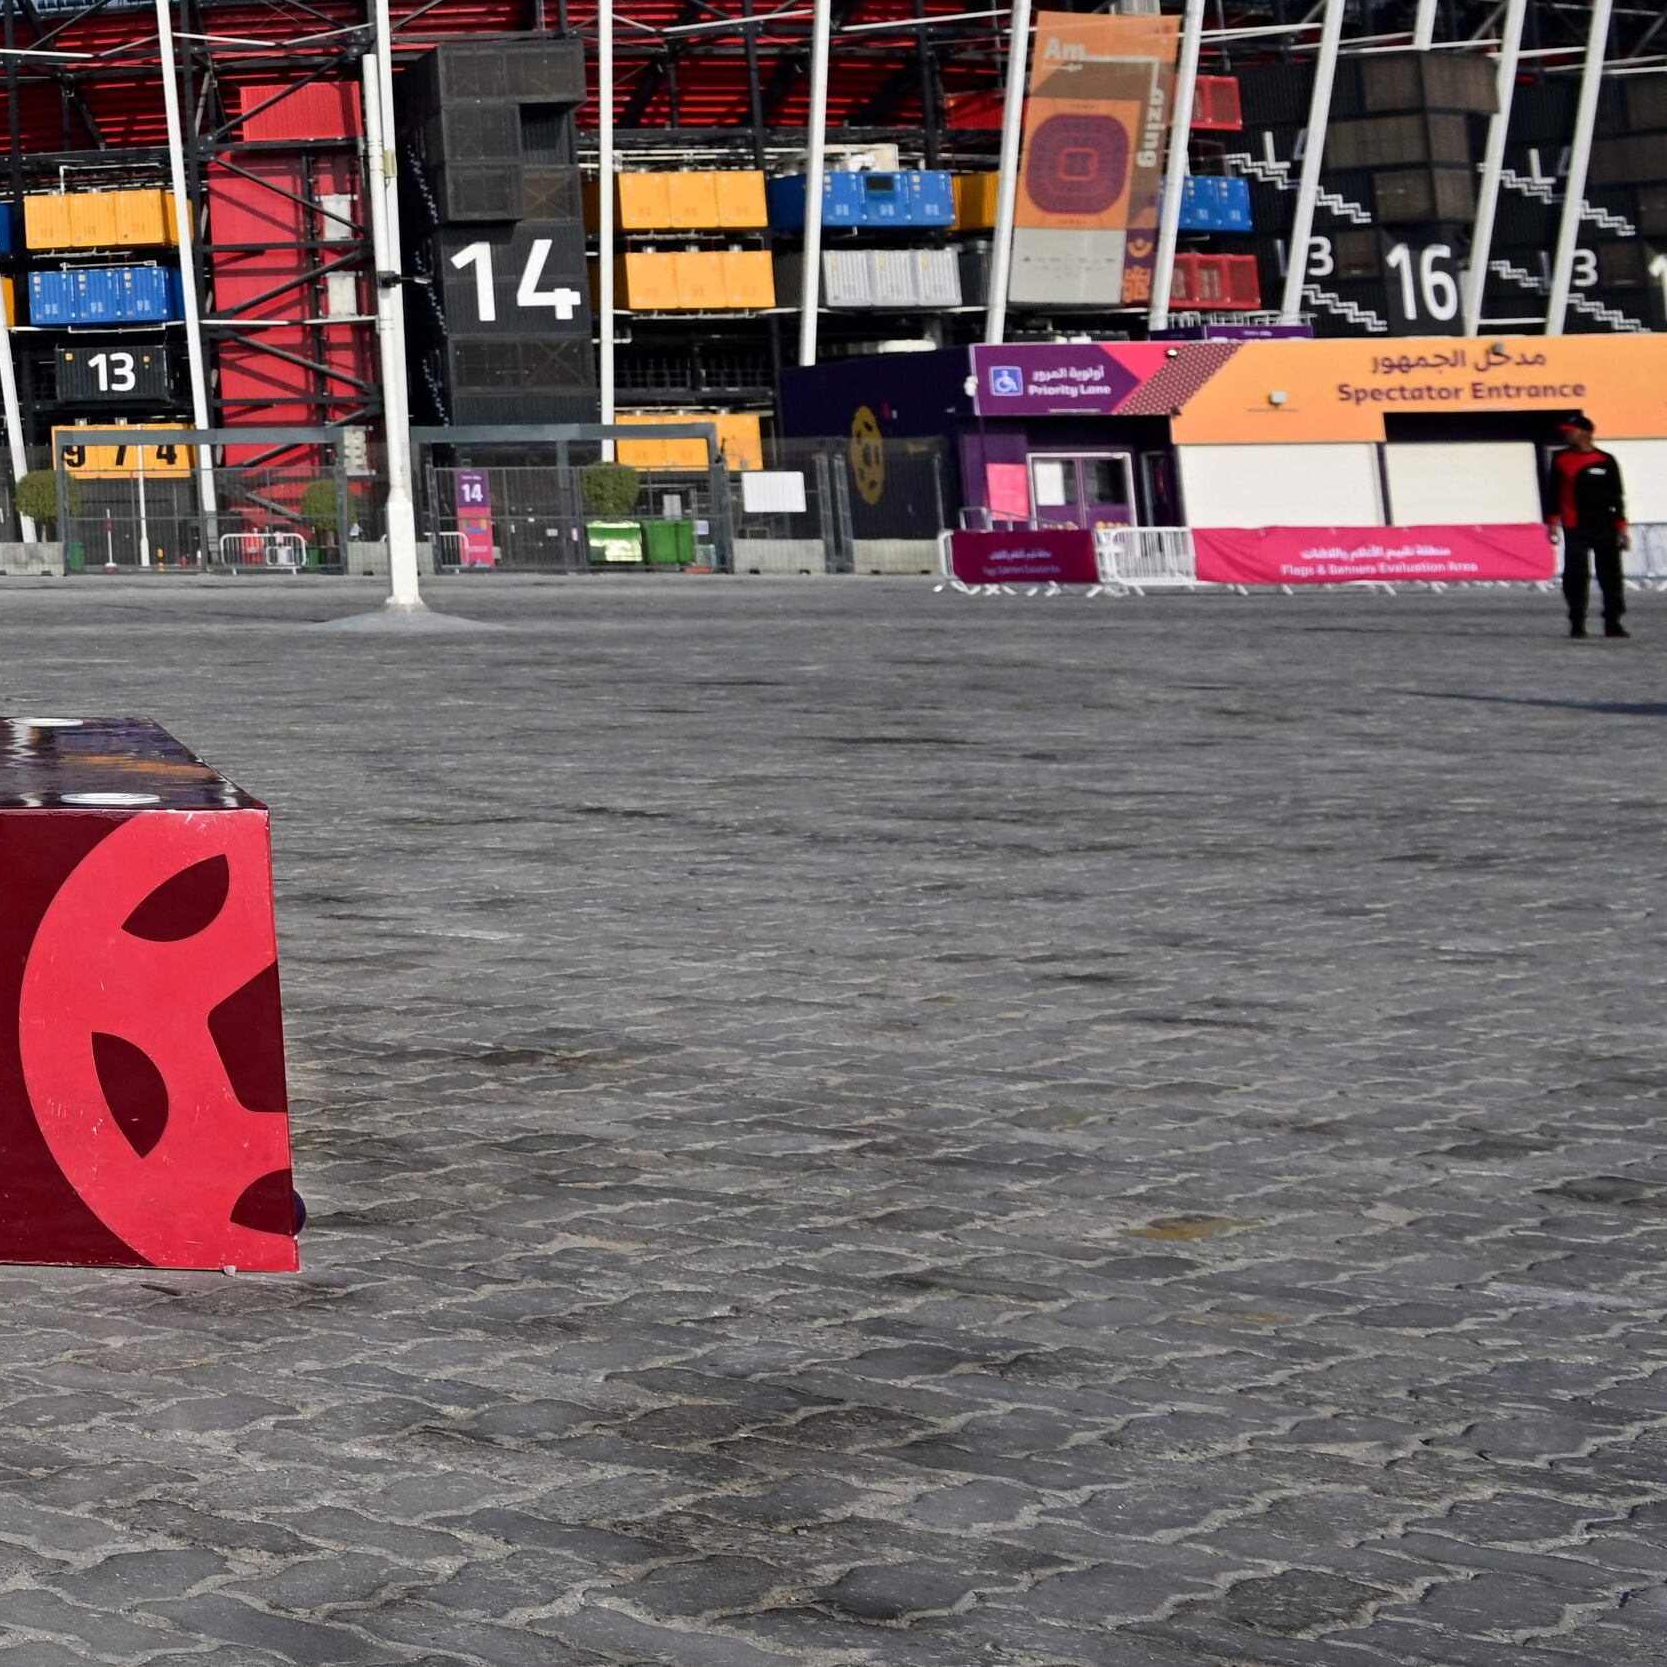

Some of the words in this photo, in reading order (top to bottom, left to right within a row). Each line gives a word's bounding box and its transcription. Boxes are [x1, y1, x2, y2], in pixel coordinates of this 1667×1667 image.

[450, 238, 582, 322] 14
[1386, 243, 1458, 322] 16
[87, 352, 136, 392] 13
[1372, 349, 1466, 375] الجمهور
[1028, 383, 1079, 398] Priority
[1080, 383, 1111, 396] Lane
[1338, 384, 1464, 406] Spectator
[1471, 382, 1586, 400] Entrance
[461, 483, 484, 502] 14
[1379, 562, 1446, 575] Evaluation
